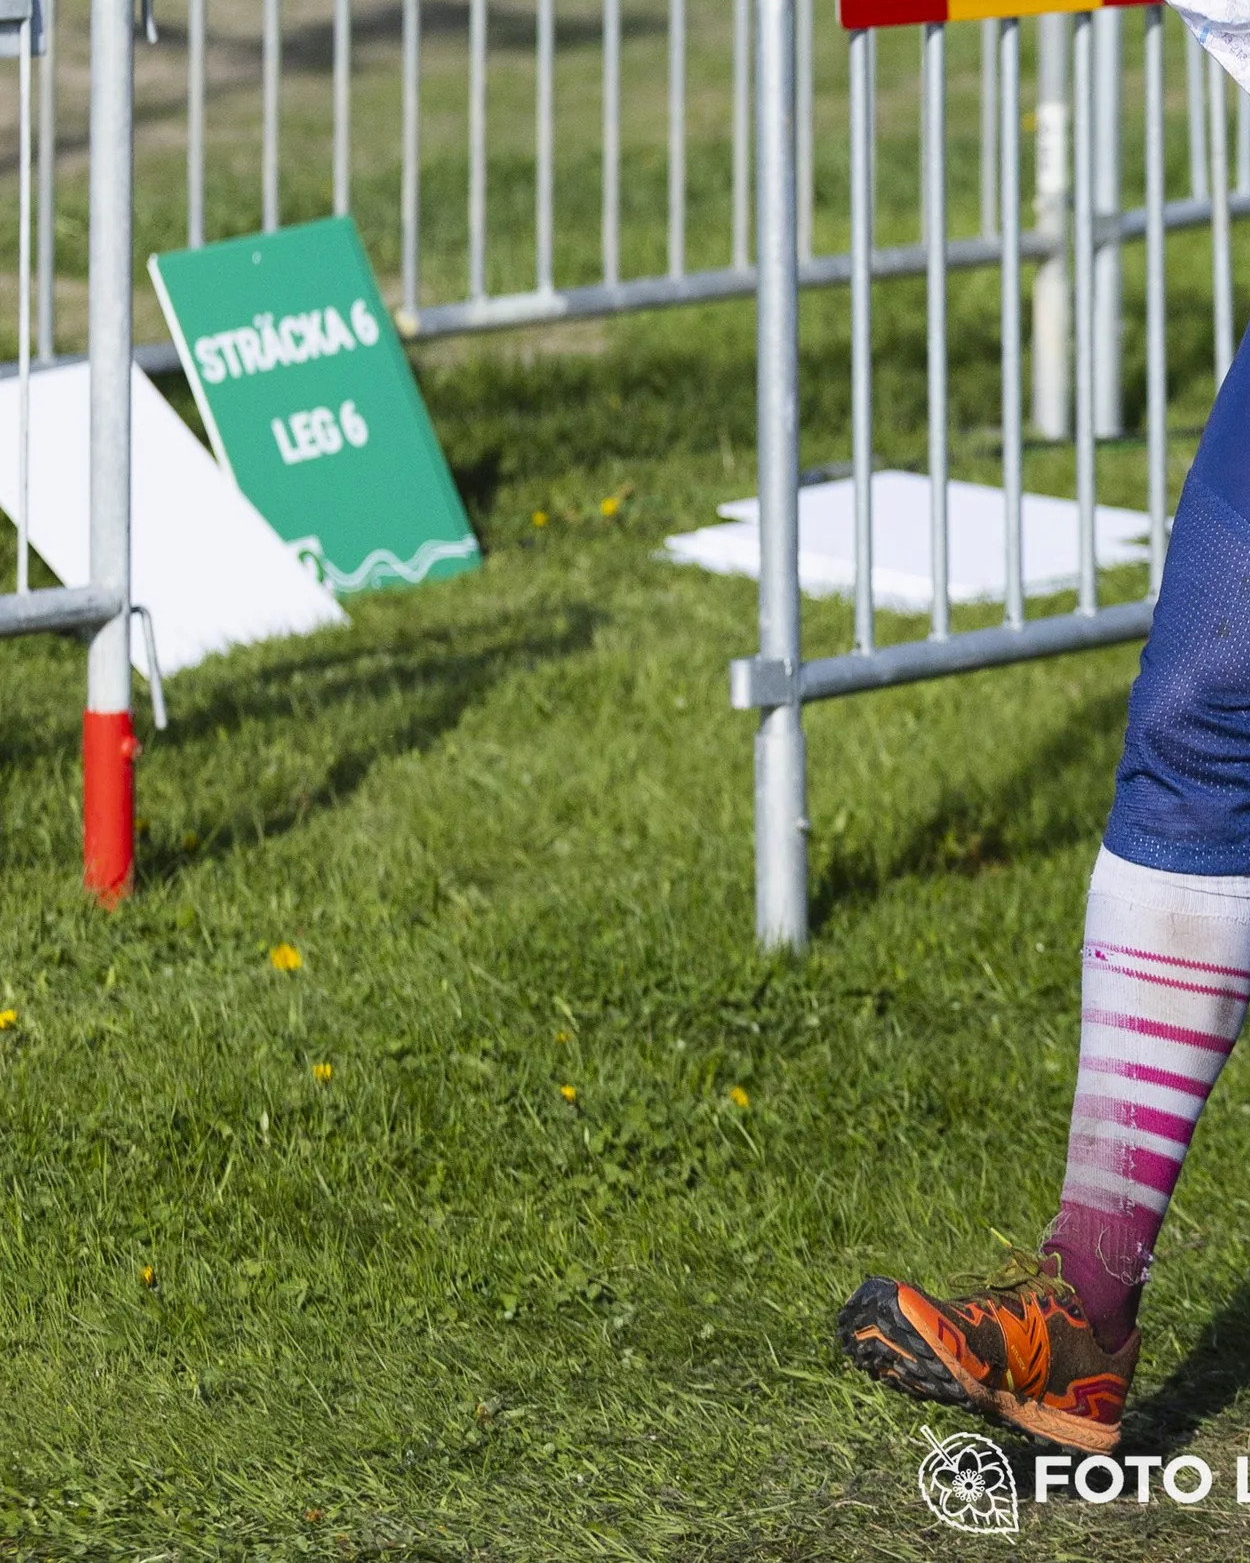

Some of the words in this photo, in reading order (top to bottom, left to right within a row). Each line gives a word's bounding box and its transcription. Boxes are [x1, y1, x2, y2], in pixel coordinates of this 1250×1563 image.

[194, 306, 355, 383] STRÄCKA
[350, 298, 380, 346] 6
[271, 405, 342, 466] LEG
[339, 399, 368, 448] 6
